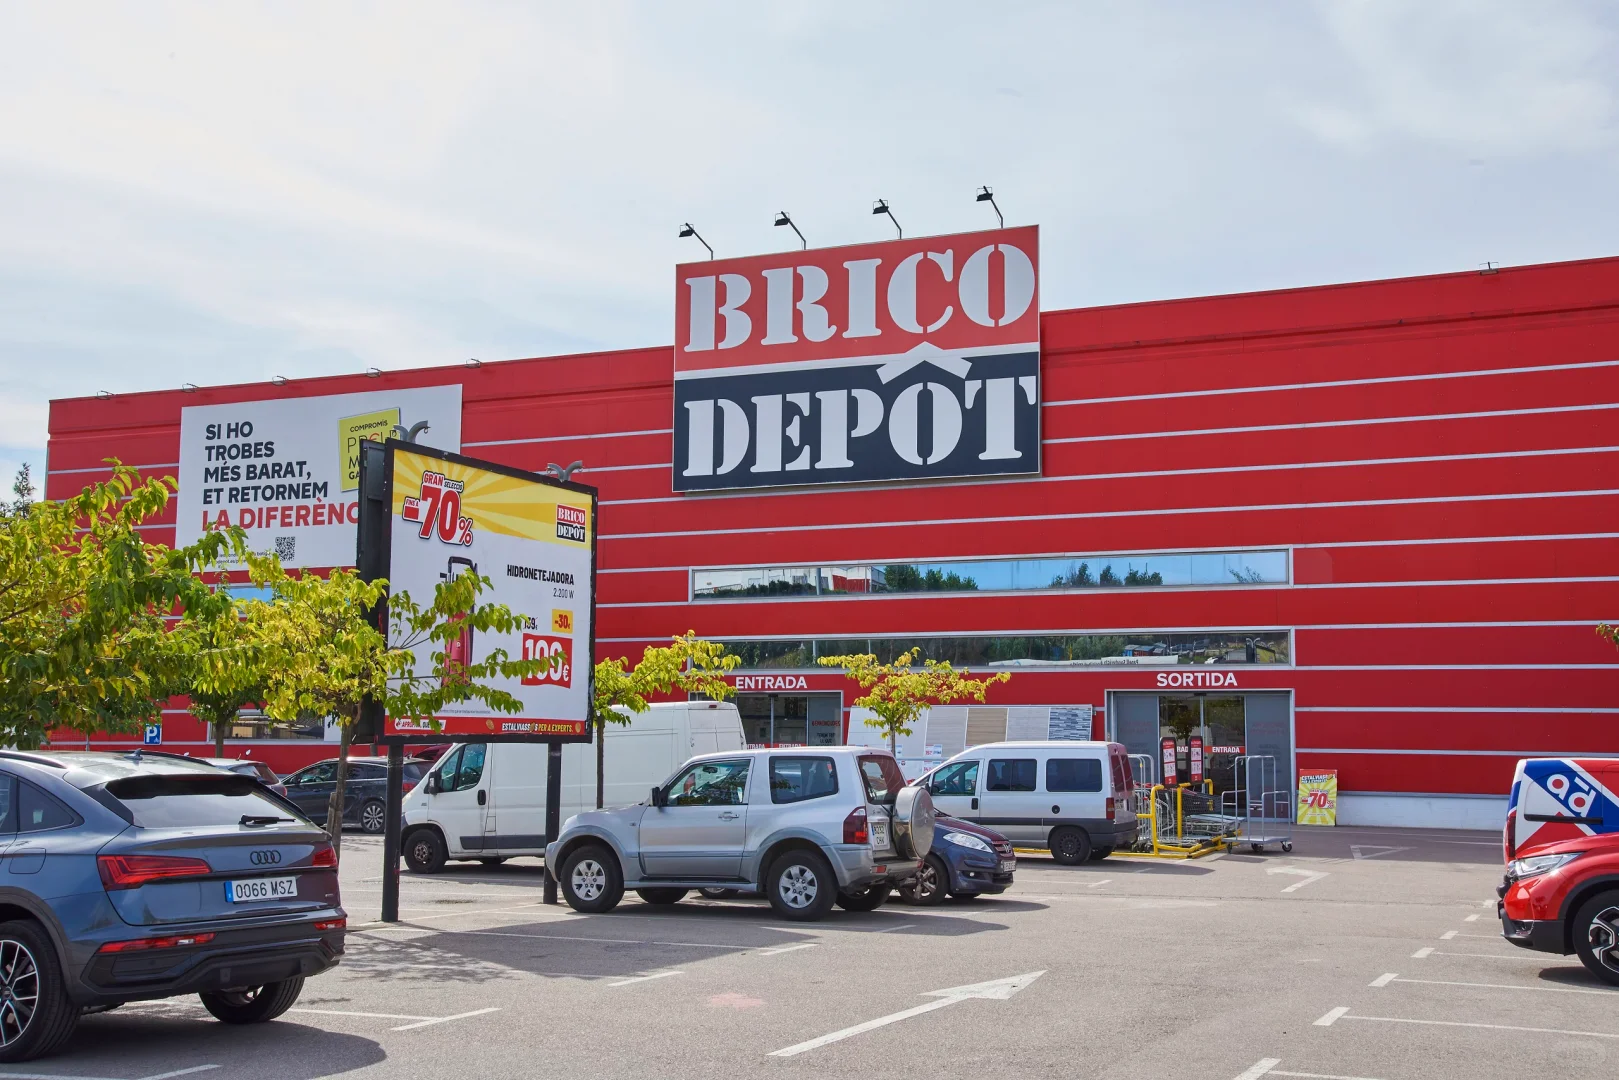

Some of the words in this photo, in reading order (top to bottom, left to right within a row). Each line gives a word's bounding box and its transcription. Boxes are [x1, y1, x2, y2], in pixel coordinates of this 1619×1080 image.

[684, 243, 1036, 353] BRICO
[682, 341, 1037, 477] DEPÔT
[205, 423, 222, 441] SI
[226, 421, 254, 439] HO
[205, 441, 275, 462] TROBES
[203, 461, 241, 483] MÉS
[245, 461, 312, 481] BARAT,
[423, 472, 444, 487] GRAN
[202, 487, 224, 505] ET
[228, 481, 329, 504] RETORNEM
[405, 498, 415, 506] FINS
[202, 509, 232, 532] LA
[239, 496, 359, 530] DIFERÈNC
[557, 507, 585, 524] BRICO
[557, 523, 585, 540] DEPÔT
[506, 564, 575, 586] HIDRONETEJADORA
[553, 587, 569, 599] 2.200
[568, 589, 575, 599] W
[735, 676, 808, 689] ENTRADA
[1156, 672, 1238, 687] SORTIDA
[146, 725, 158, 743] P
[538, 723, 548, 732] PER
[235, 882, 268, 899] 0066
[270, 879, 294, 896] MSZ
